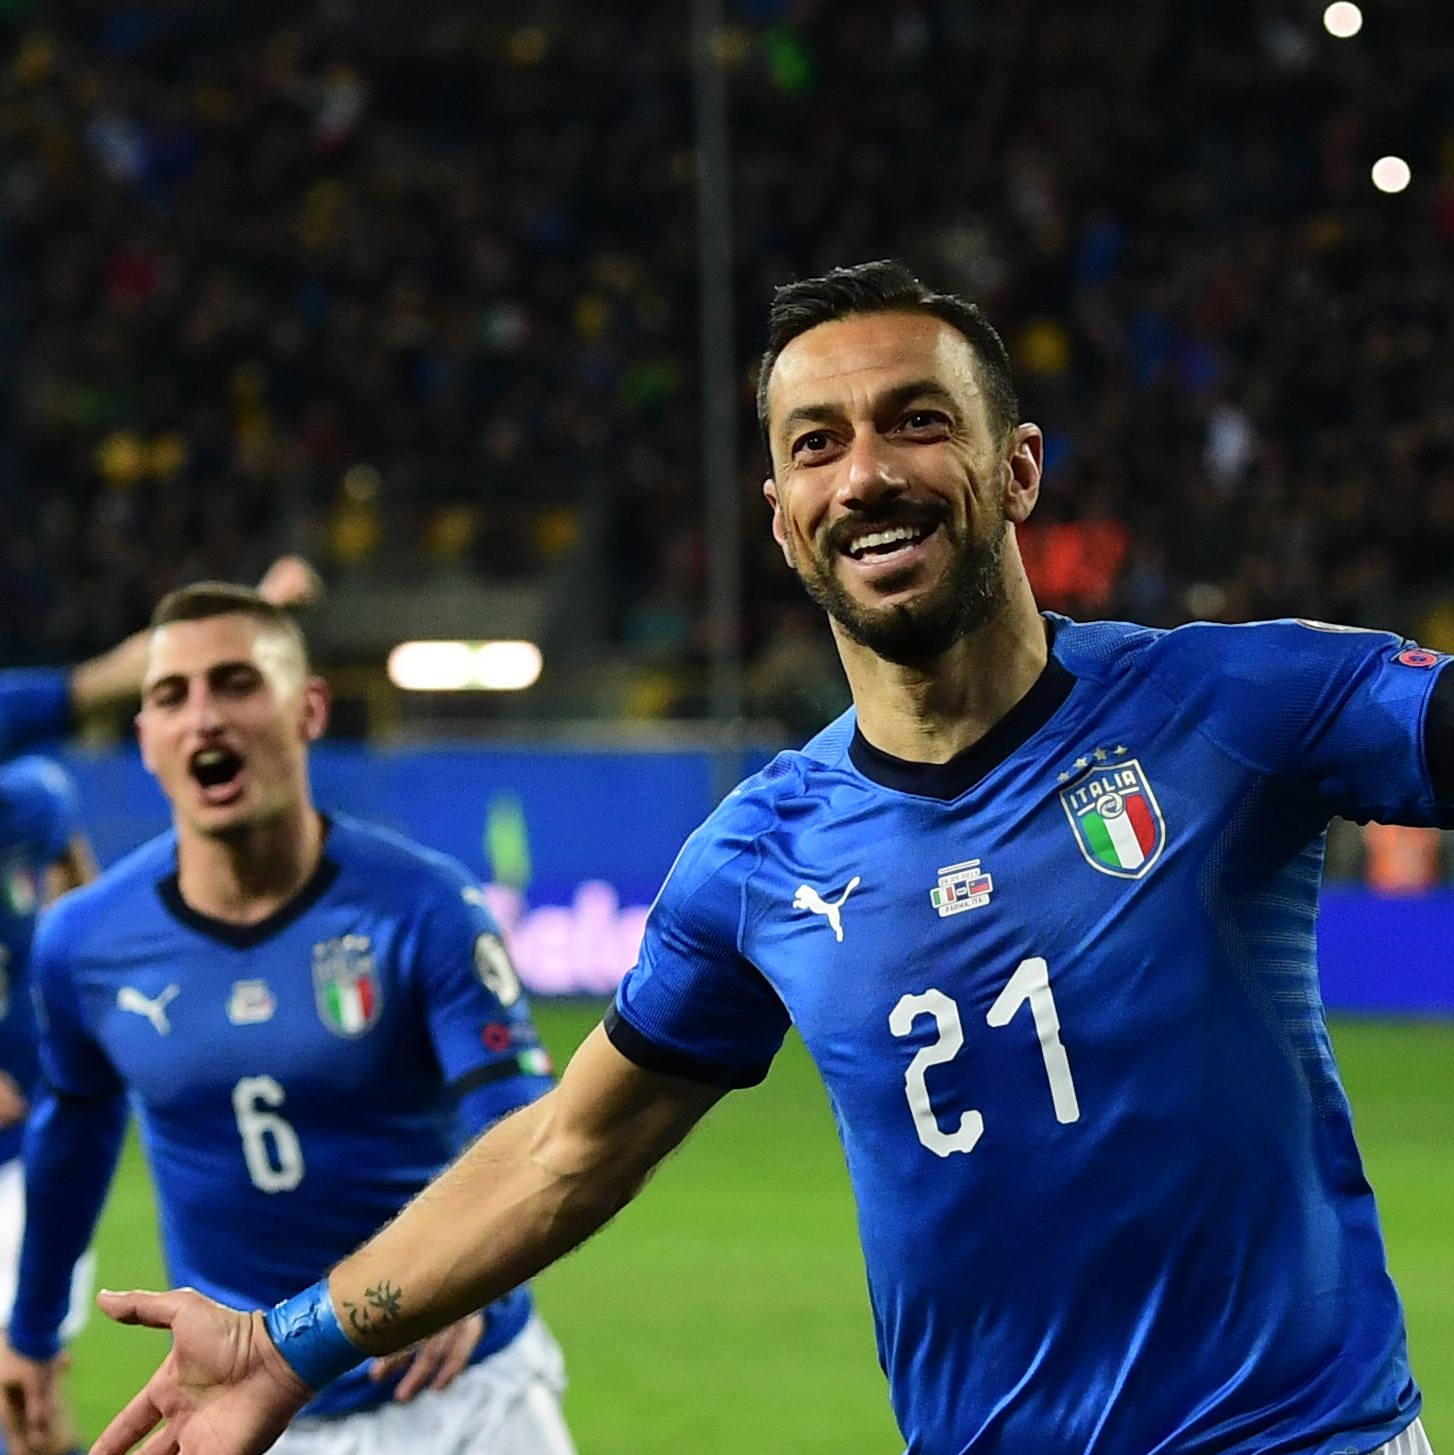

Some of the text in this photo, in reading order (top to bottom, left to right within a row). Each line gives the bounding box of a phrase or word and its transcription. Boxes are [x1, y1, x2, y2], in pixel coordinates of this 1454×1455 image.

[1069, 770, 1137, 810] ITALIA
[888, 956, 1080, 1158] 21
[231, 1073, 306, 1195] 6
